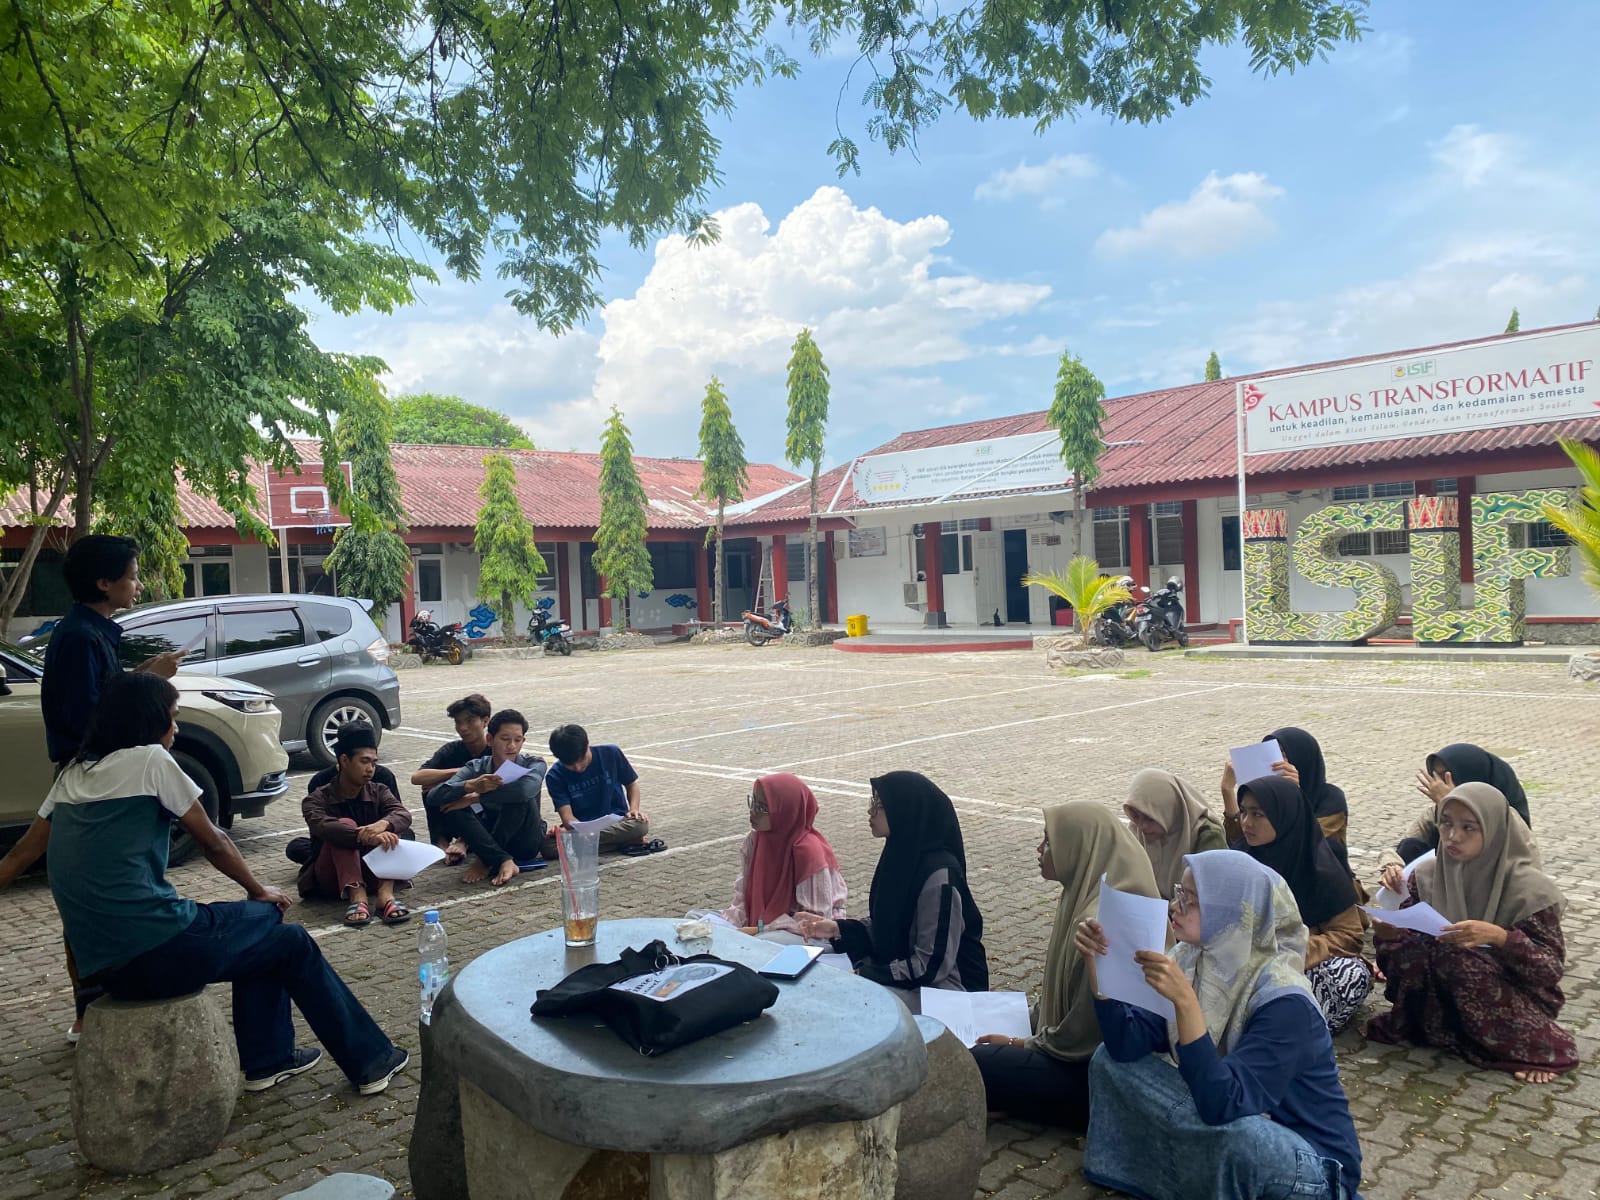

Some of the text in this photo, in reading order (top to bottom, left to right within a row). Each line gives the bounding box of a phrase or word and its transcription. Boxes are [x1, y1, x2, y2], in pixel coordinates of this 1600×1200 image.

[1268, 359, 1594, 421] KAMPUS TRANSFORMATIF
[1406, 361, 1432, 375] ISIF
[1269, 385, 1585, 433] untuk keadilan, kemanusiaan, dan kedamaian semesta
